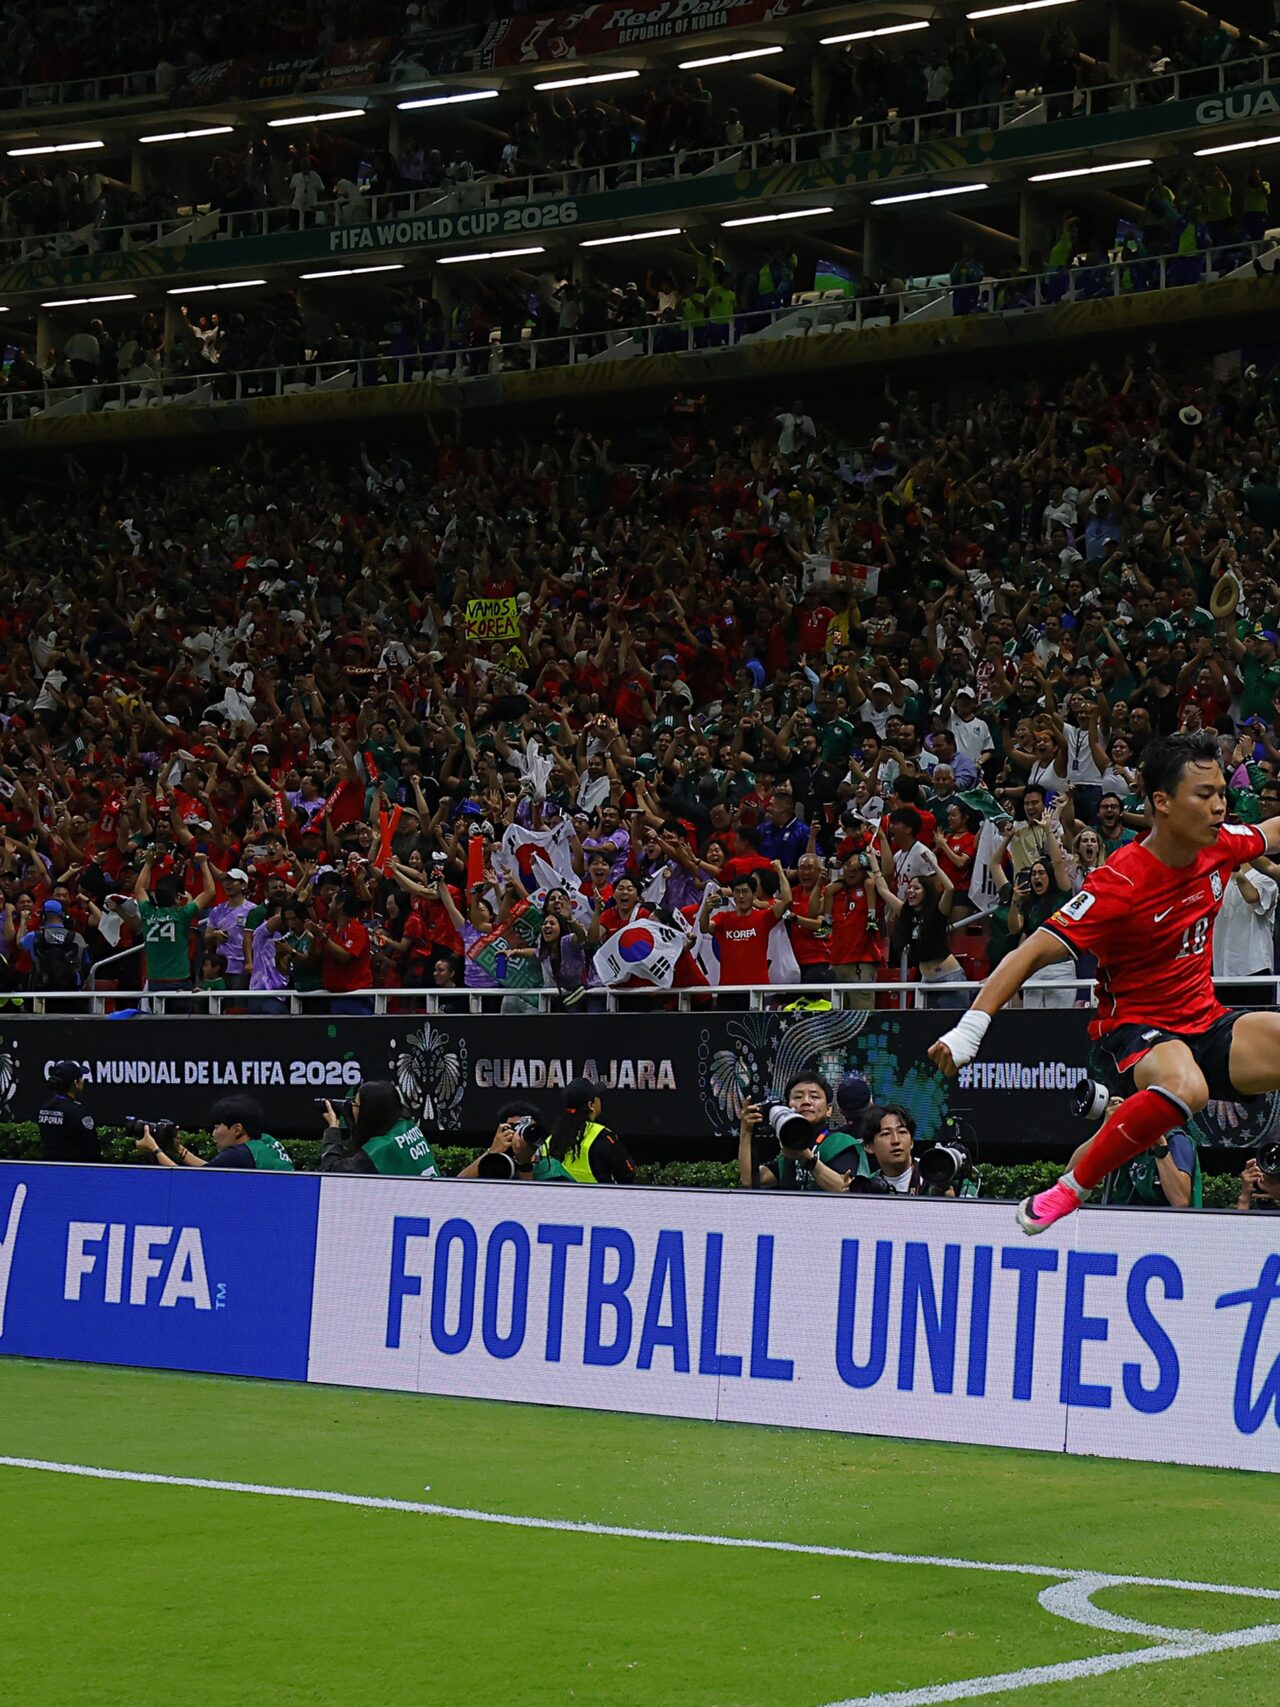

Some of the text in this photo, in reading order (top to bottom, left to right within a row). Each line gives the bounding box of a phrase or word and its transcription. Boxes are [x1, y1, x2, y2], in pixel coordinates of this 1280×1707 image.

[601, 2, 669, 30] Red
[618, 10, 728, 43] REPUBLIC OF KOREA
[330, 202, 579, 251] FIFA WORLD CUP 2026
[467, 600, 511, 618] VAMOS
[466, 618, 516, 637] KOREA
[146, 919, 176, 942] 24
[725, 928, 757, 939] KOREA
[43, 1059, 362, 1086] CA MUNDIAL DE LA FIFA 2026
[394, 1126, 424, 1149] PHOTO
[64, 1220, 213, 1312] FIFA
[385, 1214, 795, 1381] FOOTBALL
[834, 1238, 1185, 1415] UNITES
